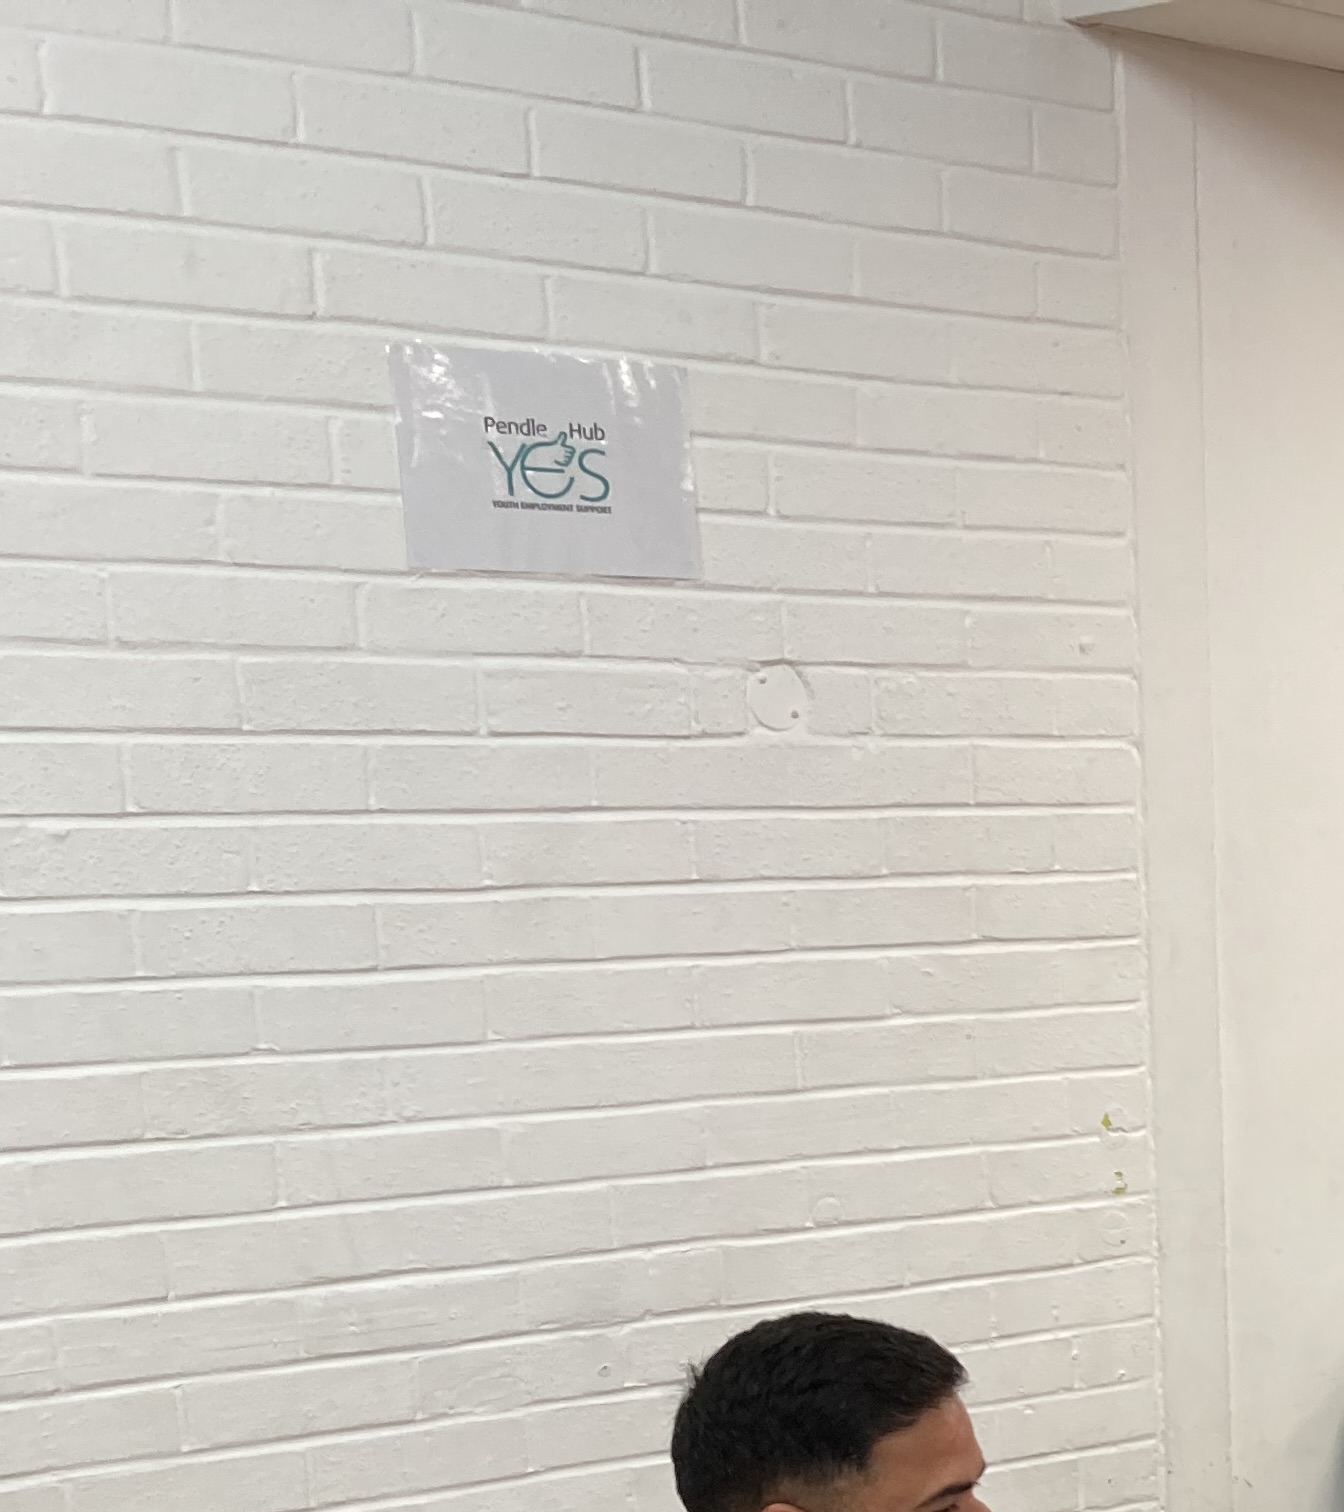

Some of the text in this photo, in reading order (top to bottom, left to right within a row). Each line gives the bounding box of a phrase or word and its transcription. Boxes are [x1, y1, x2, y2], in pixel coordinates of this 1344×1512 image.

[483, 416, 606, 441] Pendle Hub
[487, 434, 610, 502] YES
[492, 500, 612, 514] YOUTH EMPLOYMENT SUPPORT
